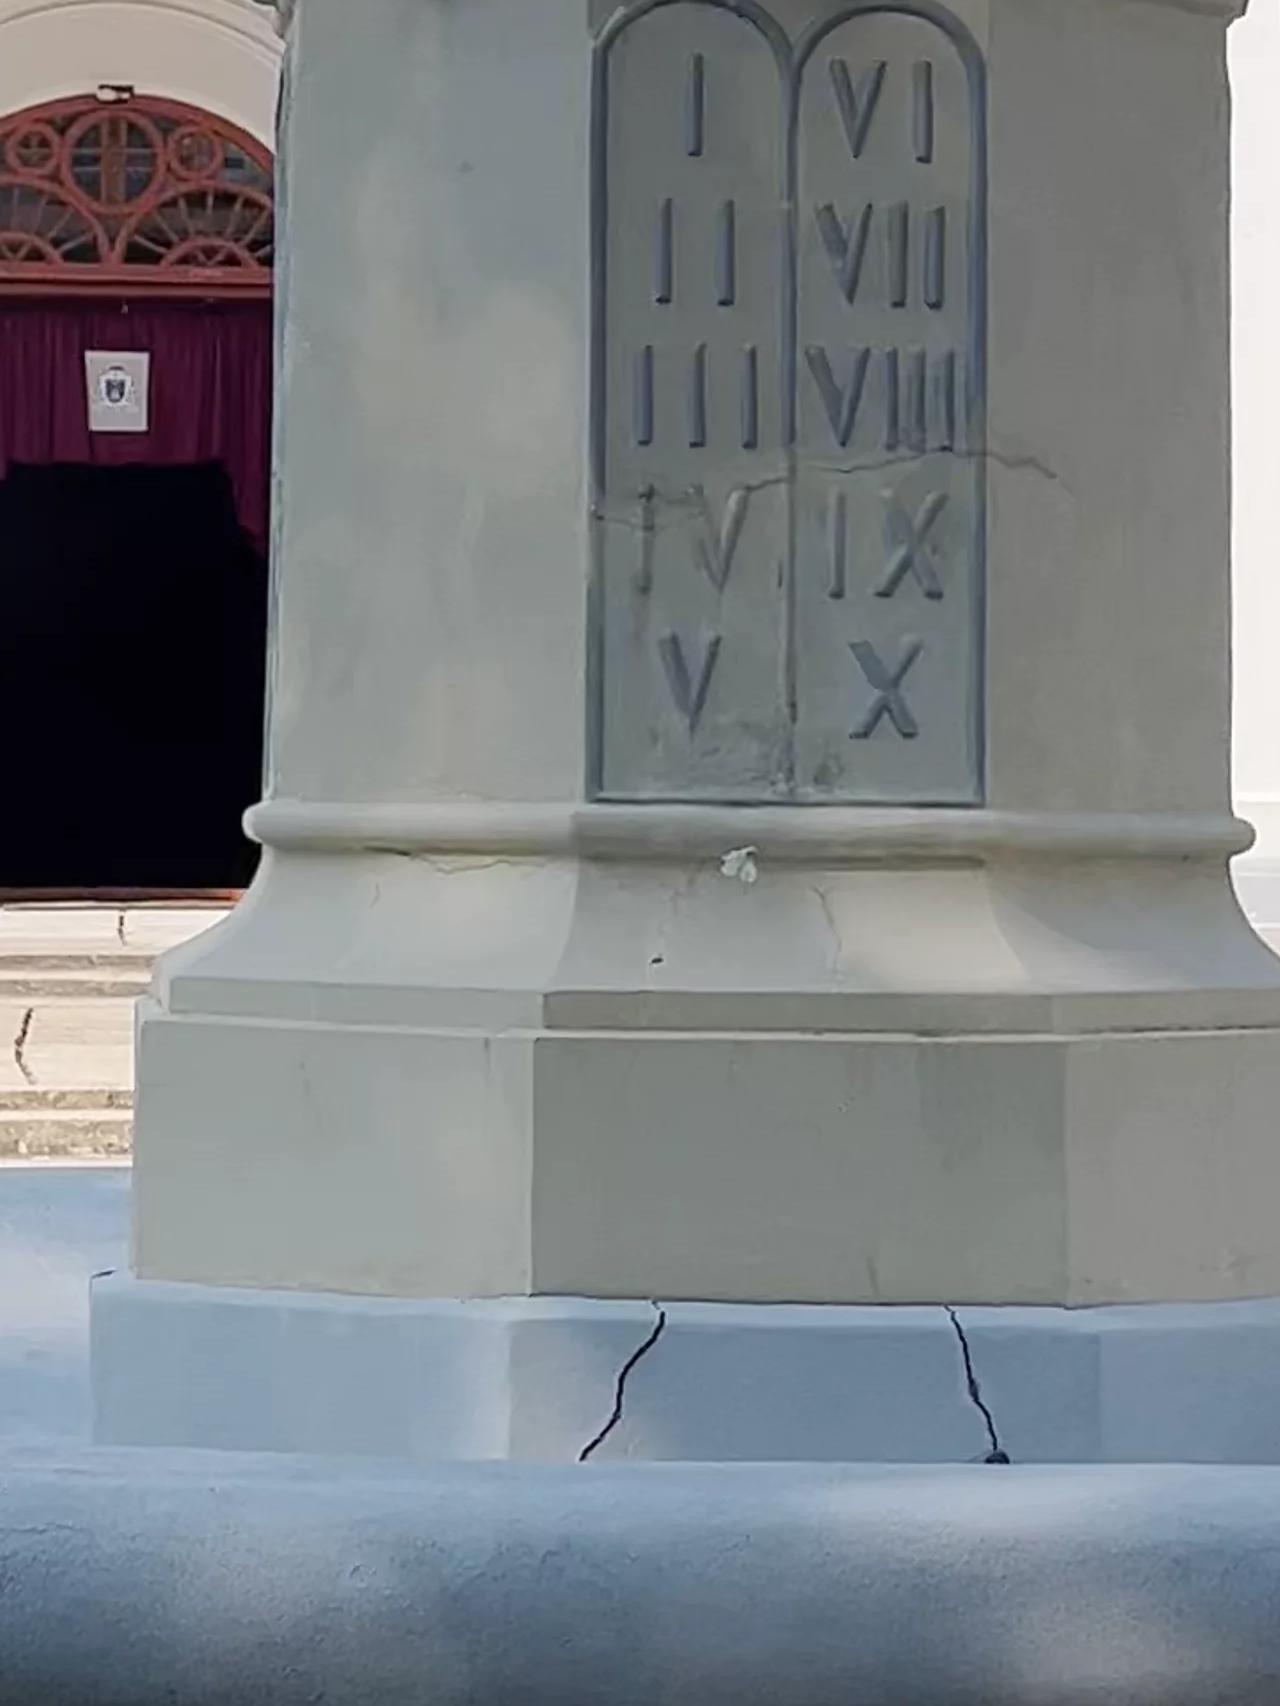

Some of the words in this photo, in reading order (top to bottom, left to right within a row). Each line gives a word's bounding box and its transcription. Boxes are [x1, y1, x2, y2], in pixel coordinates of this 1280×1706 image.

[685, 51, 705, 157] I
[829, 57, 934, 164] VI
[816, 200, 946, 308] VII
[805, 344, 956, 453] VIII
[827, 489, 950, 600] IX
[657, 628, 723, 740] V
[846, 632, 924, 739] X
